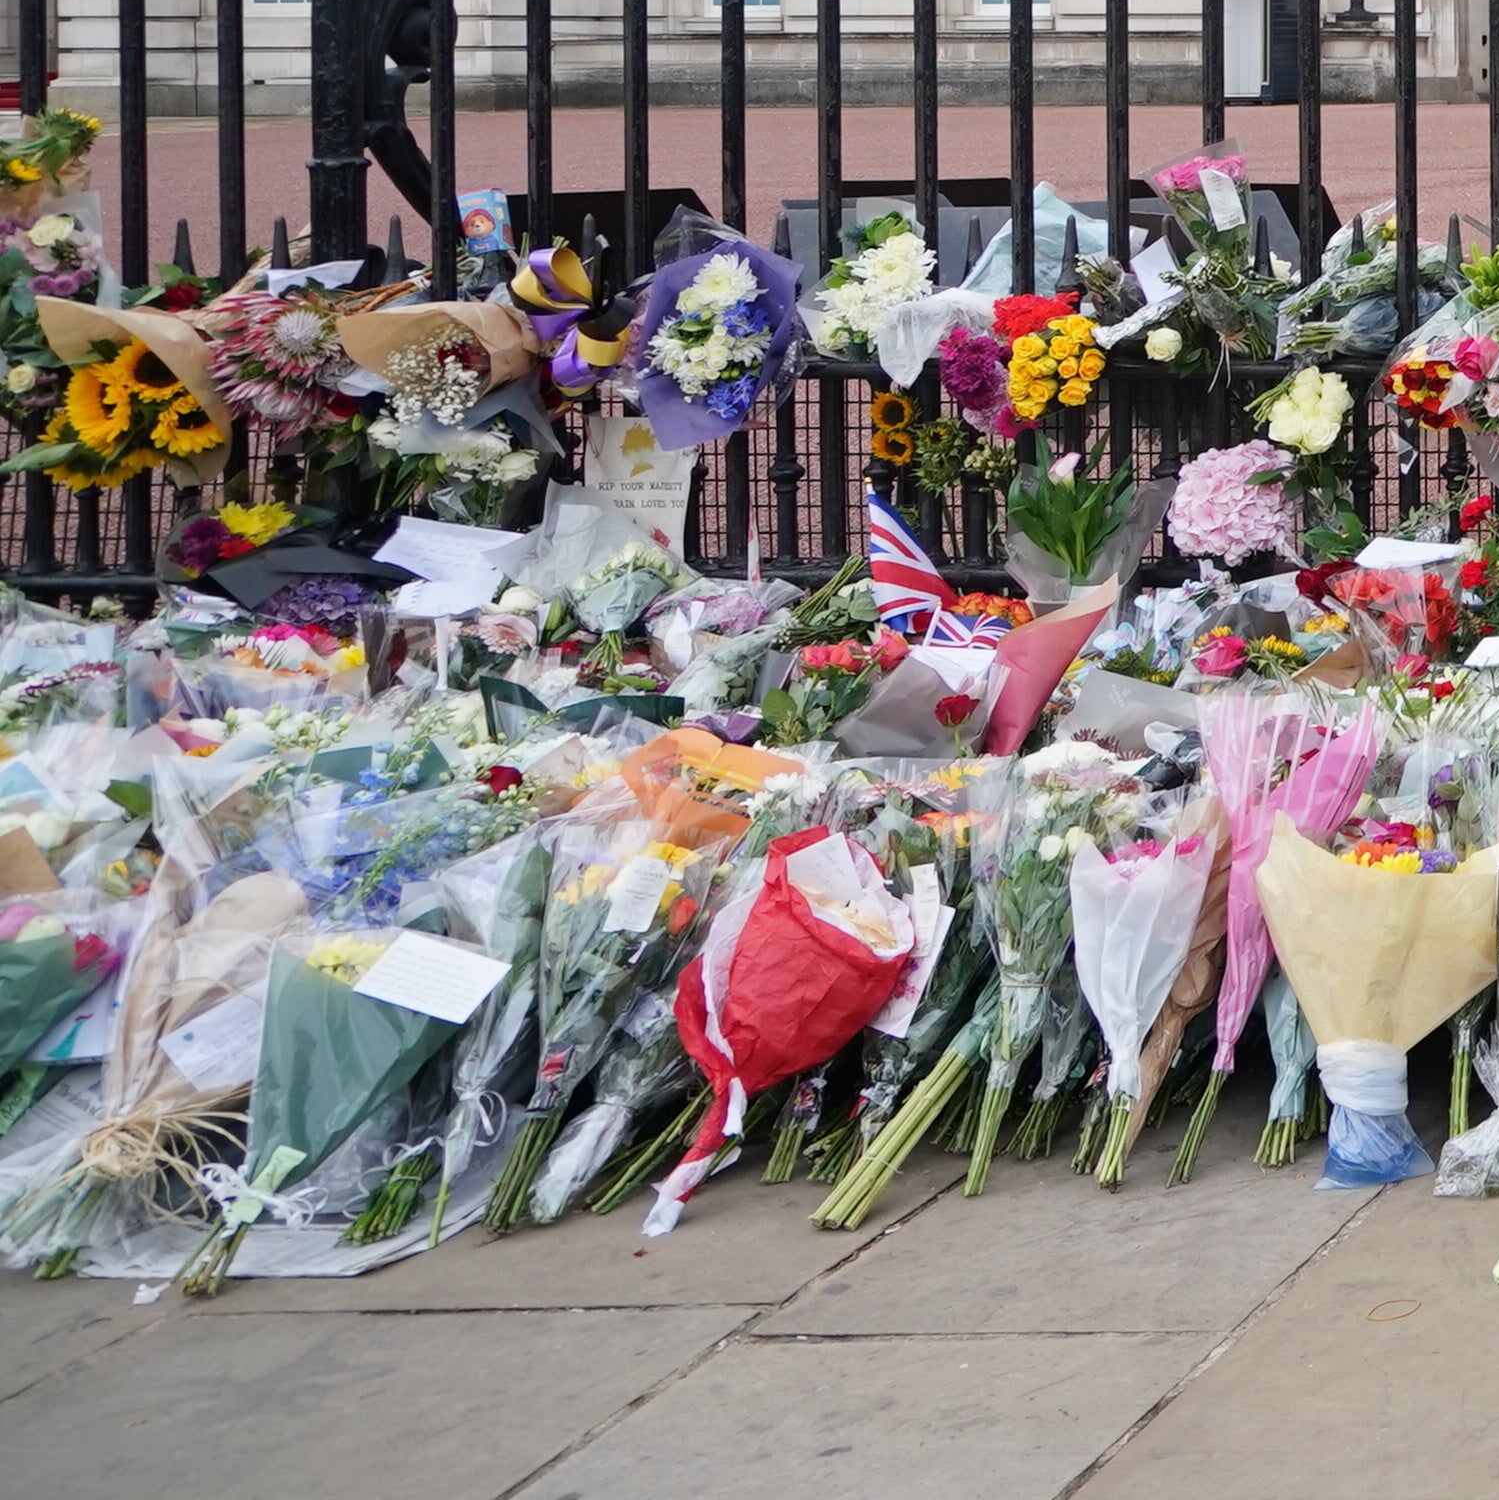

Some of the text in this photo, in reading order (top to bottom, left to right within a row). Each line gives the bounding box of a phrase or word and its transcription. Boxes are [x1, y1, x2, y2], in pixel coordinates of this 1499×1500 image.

[598, 481, 683, 491] RIP YOUR MAJESTY
[641, 499, 667, 509] LOVES
